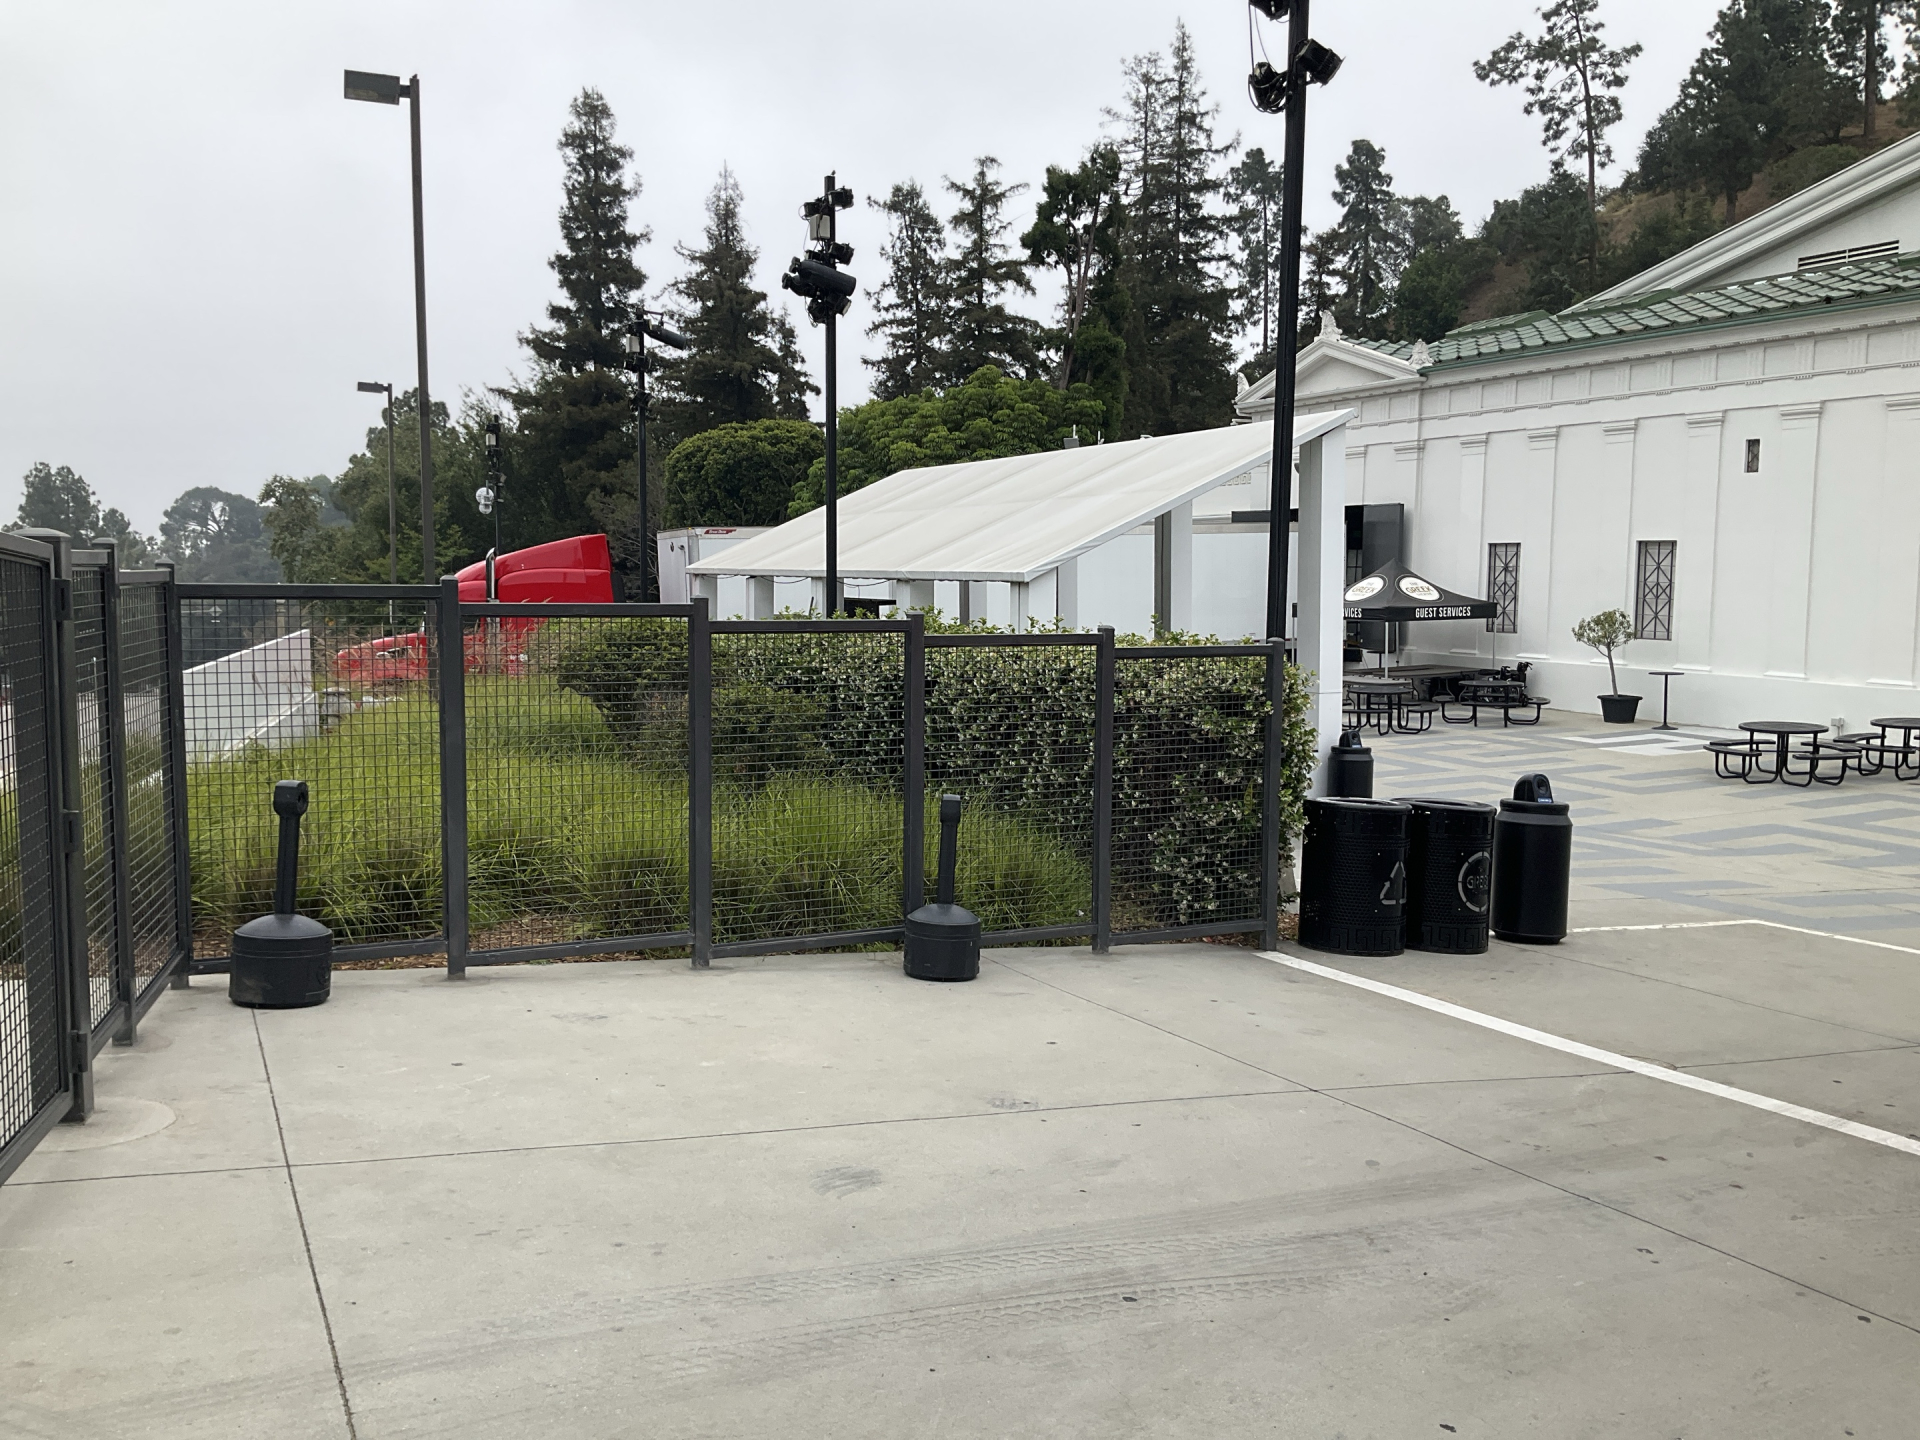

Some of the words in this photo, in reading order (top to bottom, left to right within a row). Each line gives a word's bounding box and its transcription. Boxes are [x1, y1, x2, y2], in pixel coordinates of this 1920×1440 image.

[1343, 607, 1362, 618] VICES
[1415, 607, 1437, 618] GUEST
[1438, 606, 1471, 617] SERVICES
